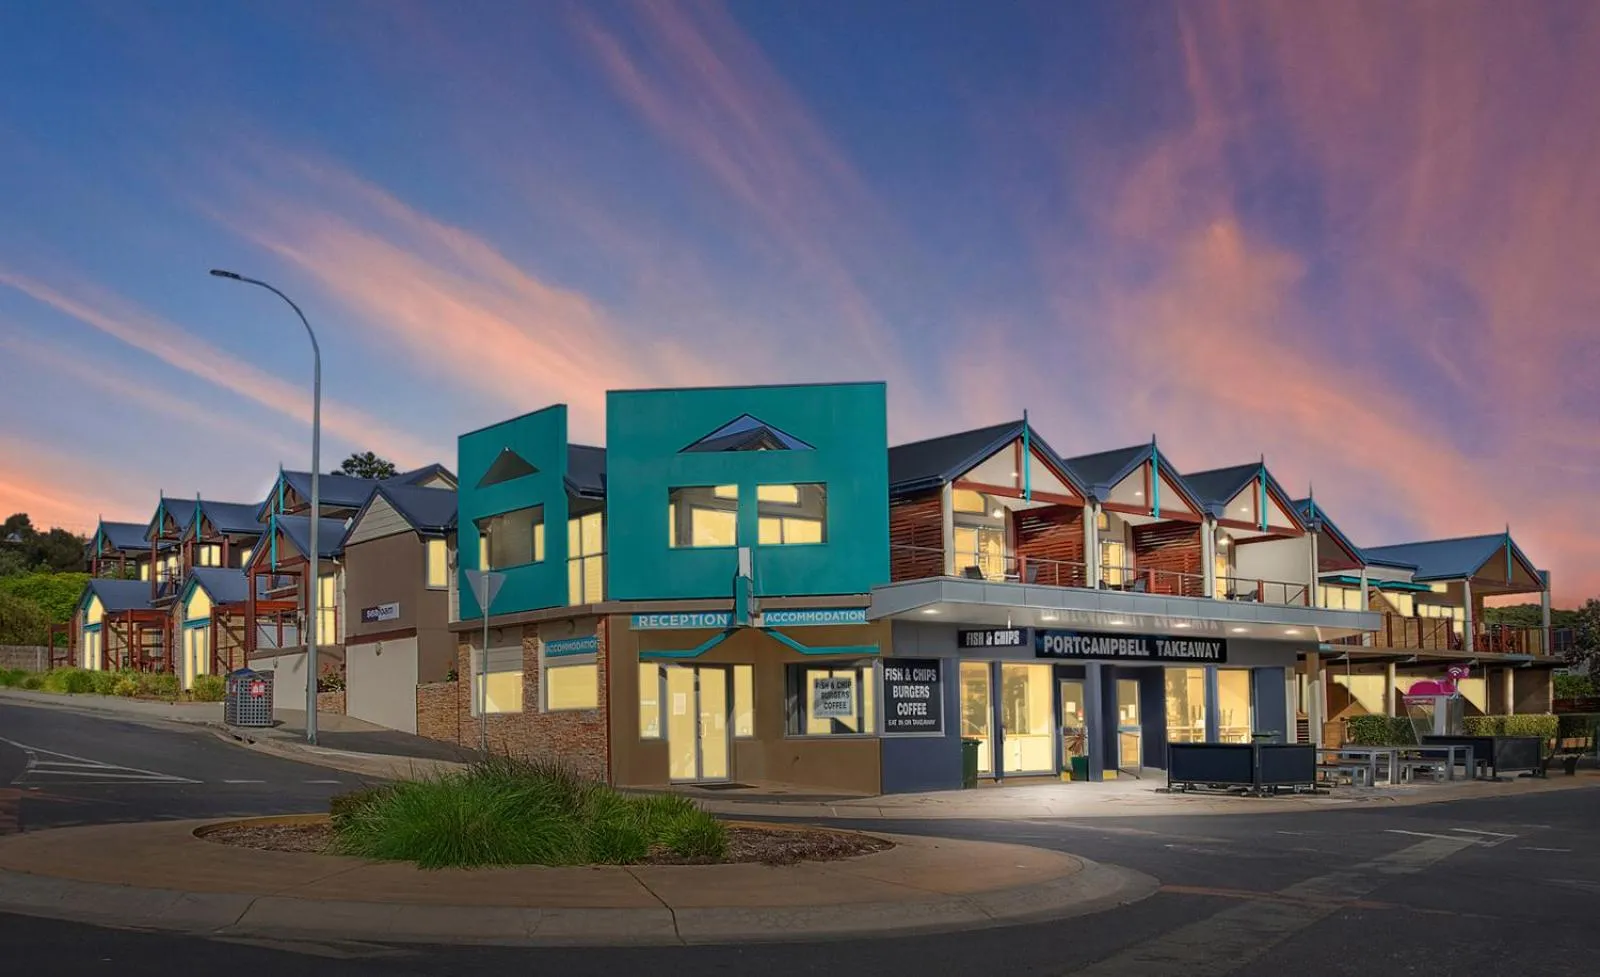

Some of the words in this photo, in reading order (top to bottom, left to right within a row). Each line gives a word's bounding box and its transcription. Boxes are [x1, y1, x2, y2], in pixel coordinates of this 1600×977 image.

[639, 613, 728, 627] RECEPTION
[766, 610, 866, 623] ACCOMMODATION
[966, 631, 985, 646] FISH
[986, 631, 993, 645] &
[994, 630, 1020, 645] CHIPS
[1043, 635, 1149, 656] PORTCAMPBELL
[1156, 640, 1220, 659] TAKEAWAY
[884, 667, 903, 681] FISH
[905, 667, 911, 681] &
[912, 668, 937, 681] CHIPS
[820, 690, 850, 700] BURGERS
[892, 685, 930, 699] BURGERS
[823, 701, 847, 710] COFFEE
[896, 702, 928, 716] COFFEE
